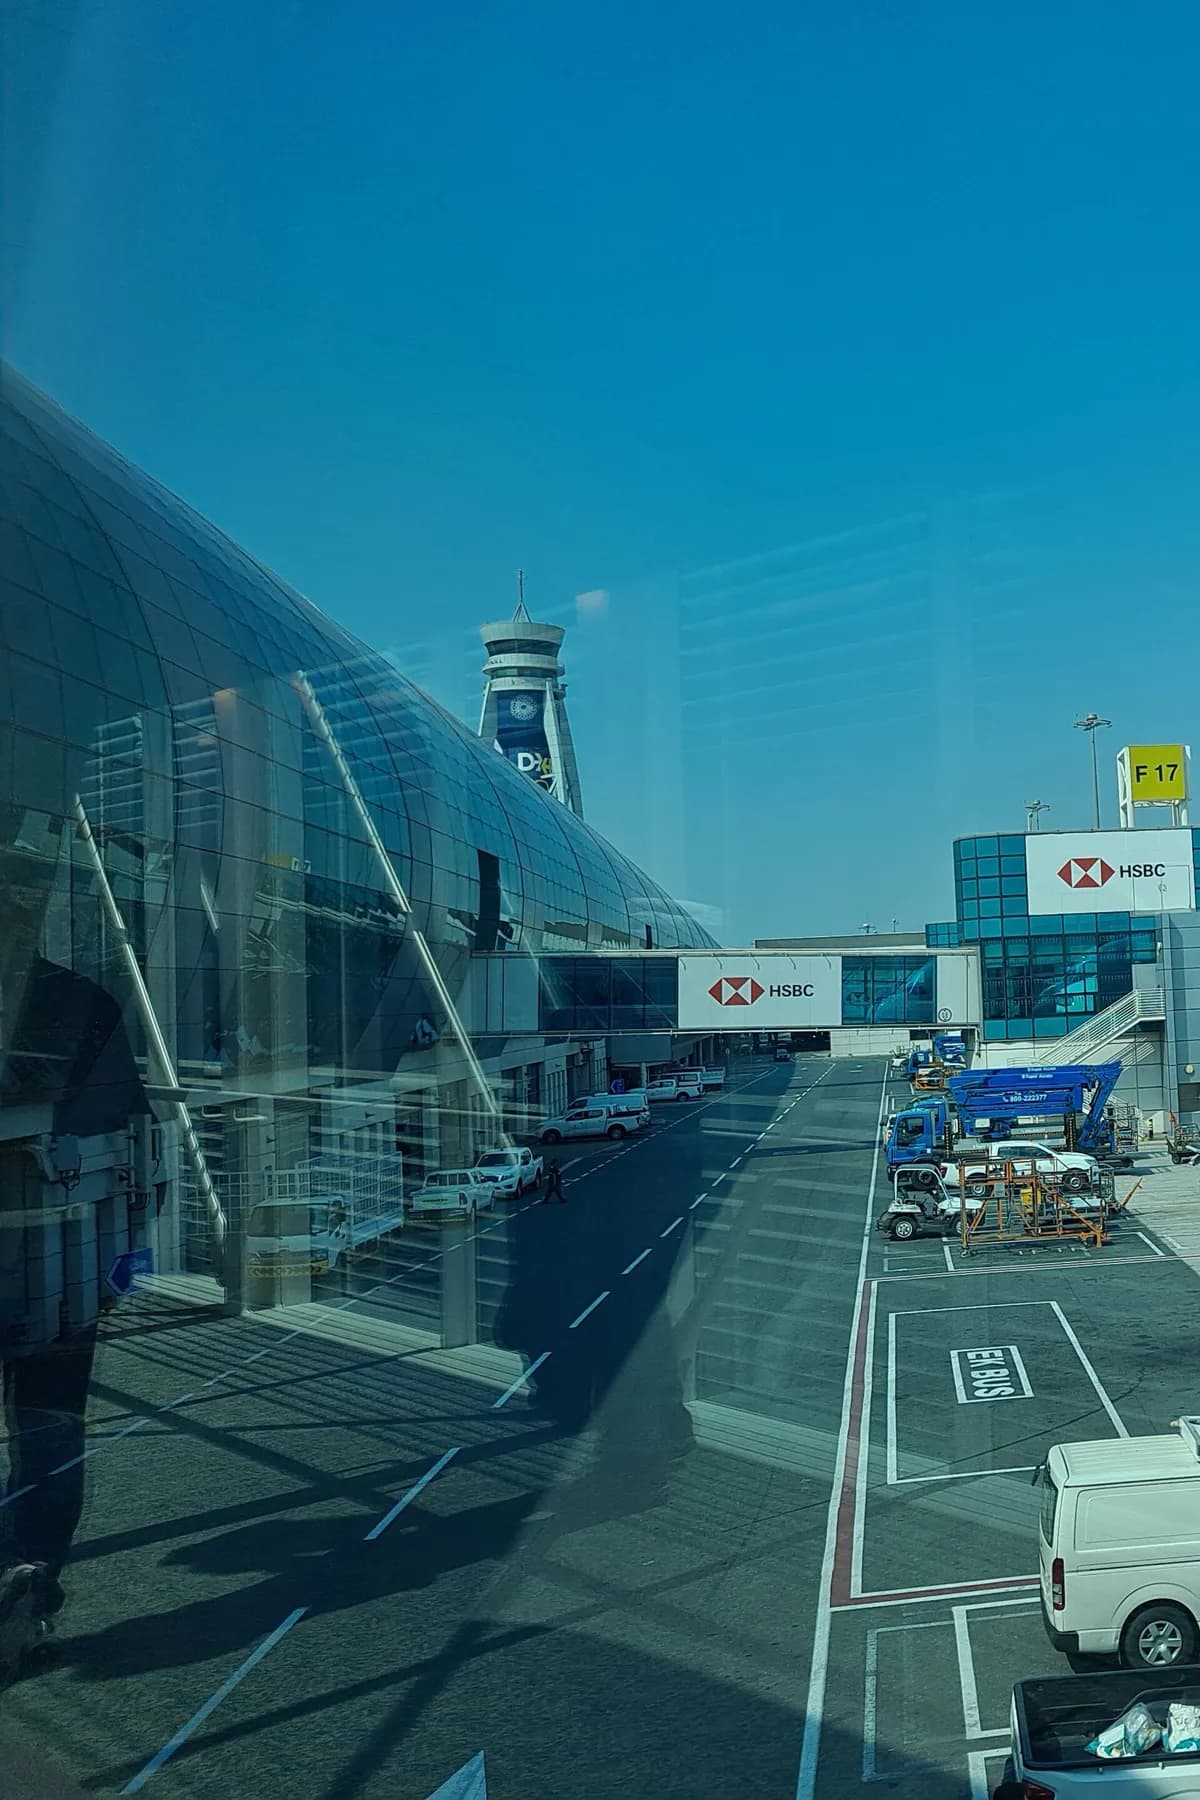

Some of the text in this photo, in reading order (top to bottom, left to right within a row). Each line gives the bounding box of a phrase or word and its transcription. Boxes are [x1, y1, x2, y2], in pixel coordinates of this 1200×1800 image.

[1135, 763, 1178, 783] F 17
[1119, 863, 1165, 878] HSBC
[769, 984, 814, 998] HSBC
[966, 1349, 1015, 1398] EK BUS
